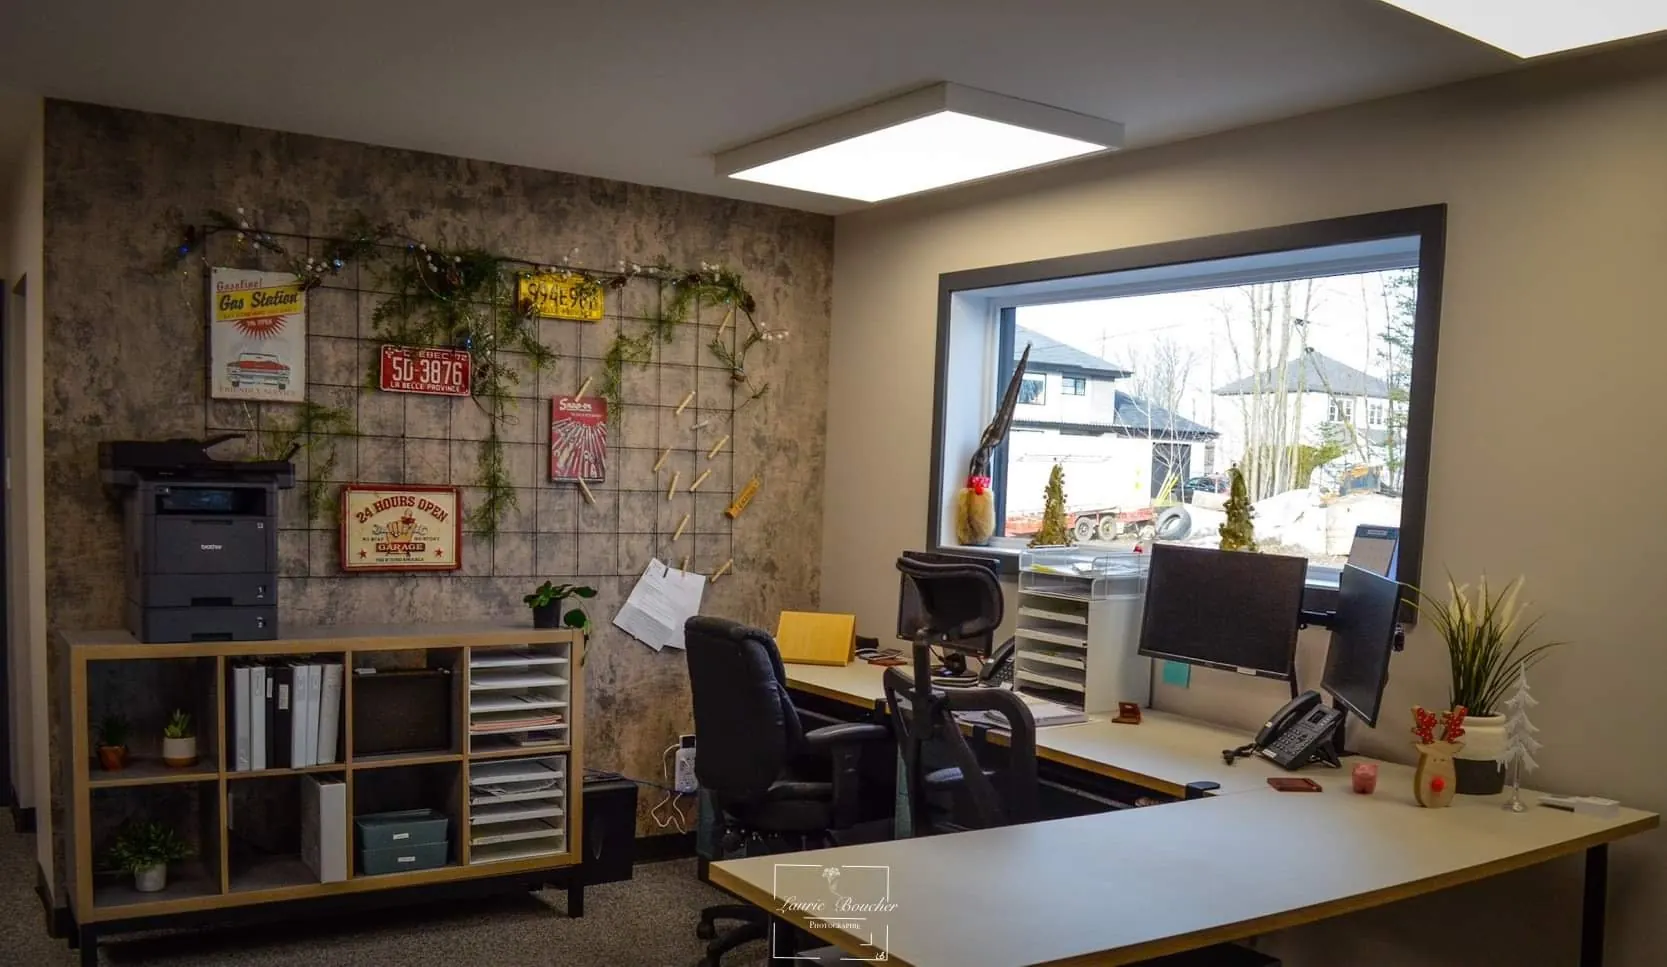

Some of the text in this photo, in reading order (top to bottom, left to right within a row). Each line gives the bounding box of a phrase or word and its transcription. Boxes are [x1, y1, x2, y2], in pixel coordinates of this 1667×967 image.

[220, 290, 298, 312] Gas Station
[355, 495, 449, 523] 24 HOURS OPEN
